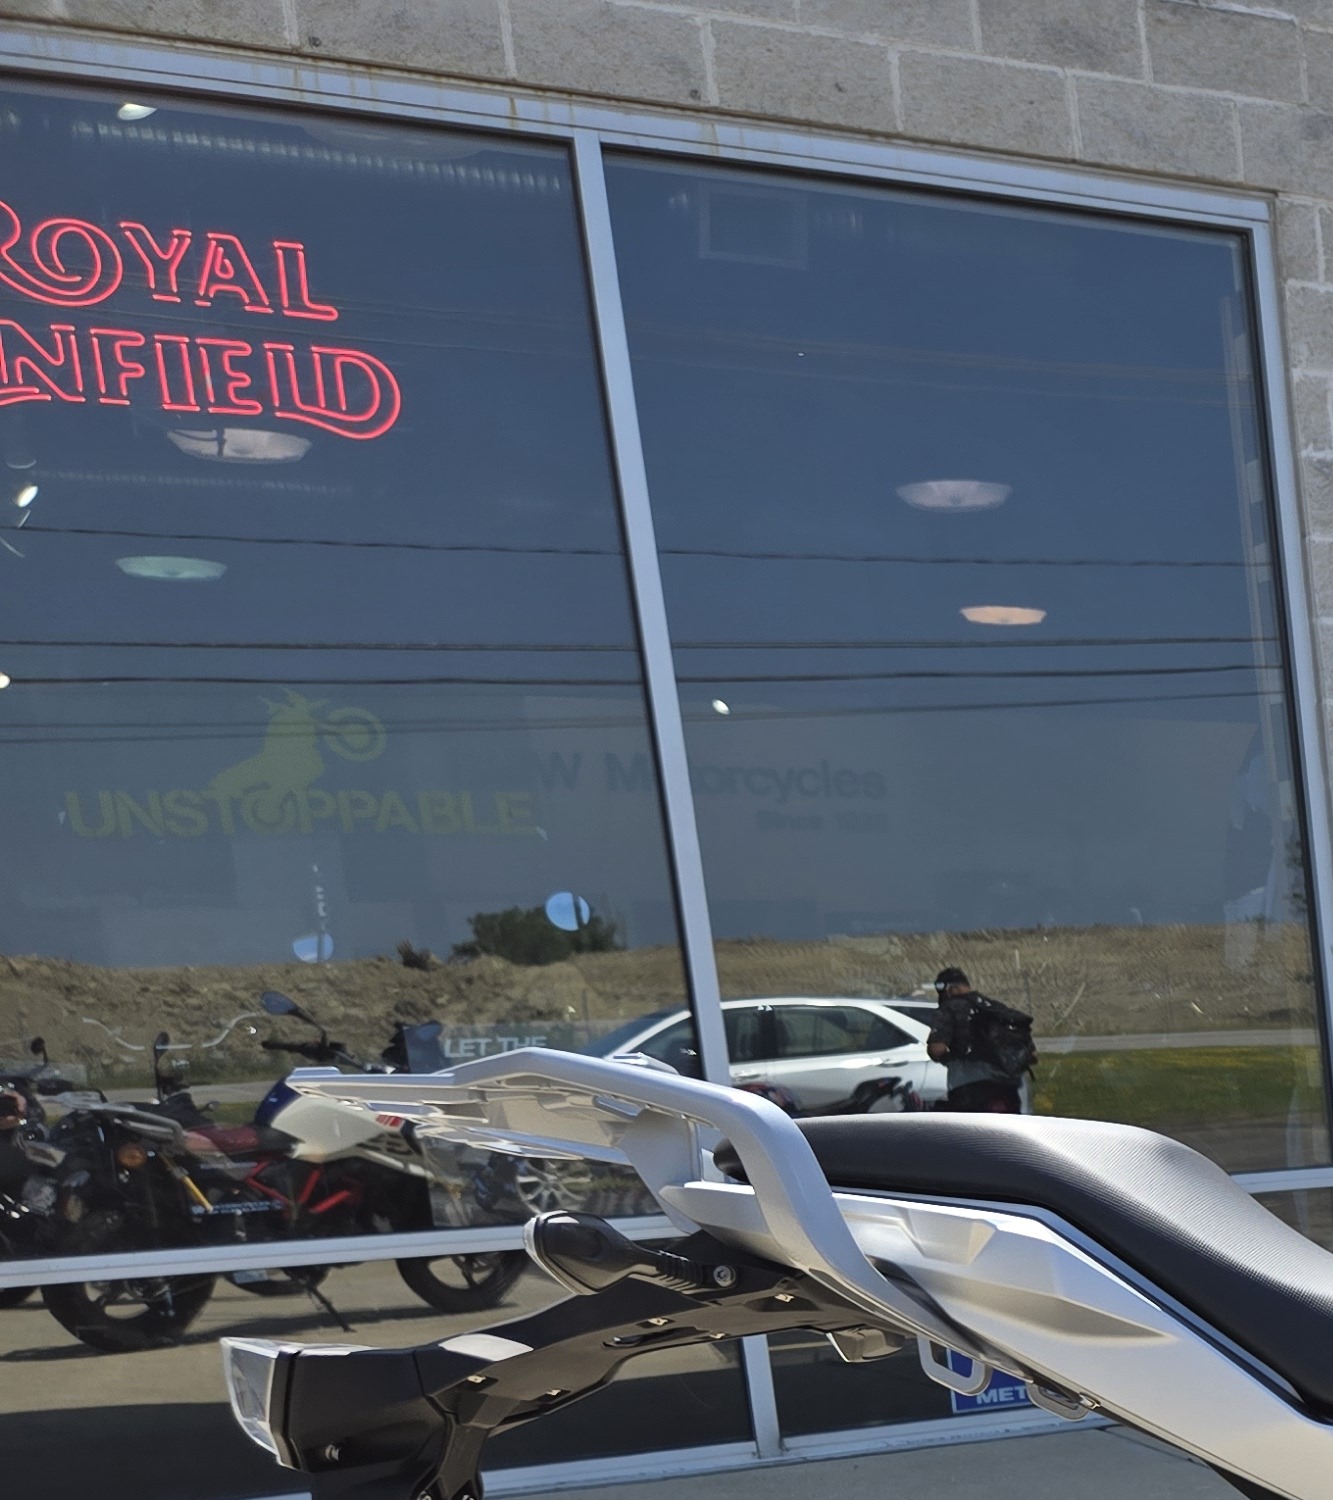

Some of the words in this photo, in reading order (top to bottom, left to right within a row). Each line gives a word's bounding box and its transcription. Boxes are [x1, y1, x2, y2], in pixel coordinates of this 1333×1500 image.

[0, 318, 401, 440] NFIELD
[604, 752, 888, 804] Morcycles
[444, 1037, 492, 1058] LET
